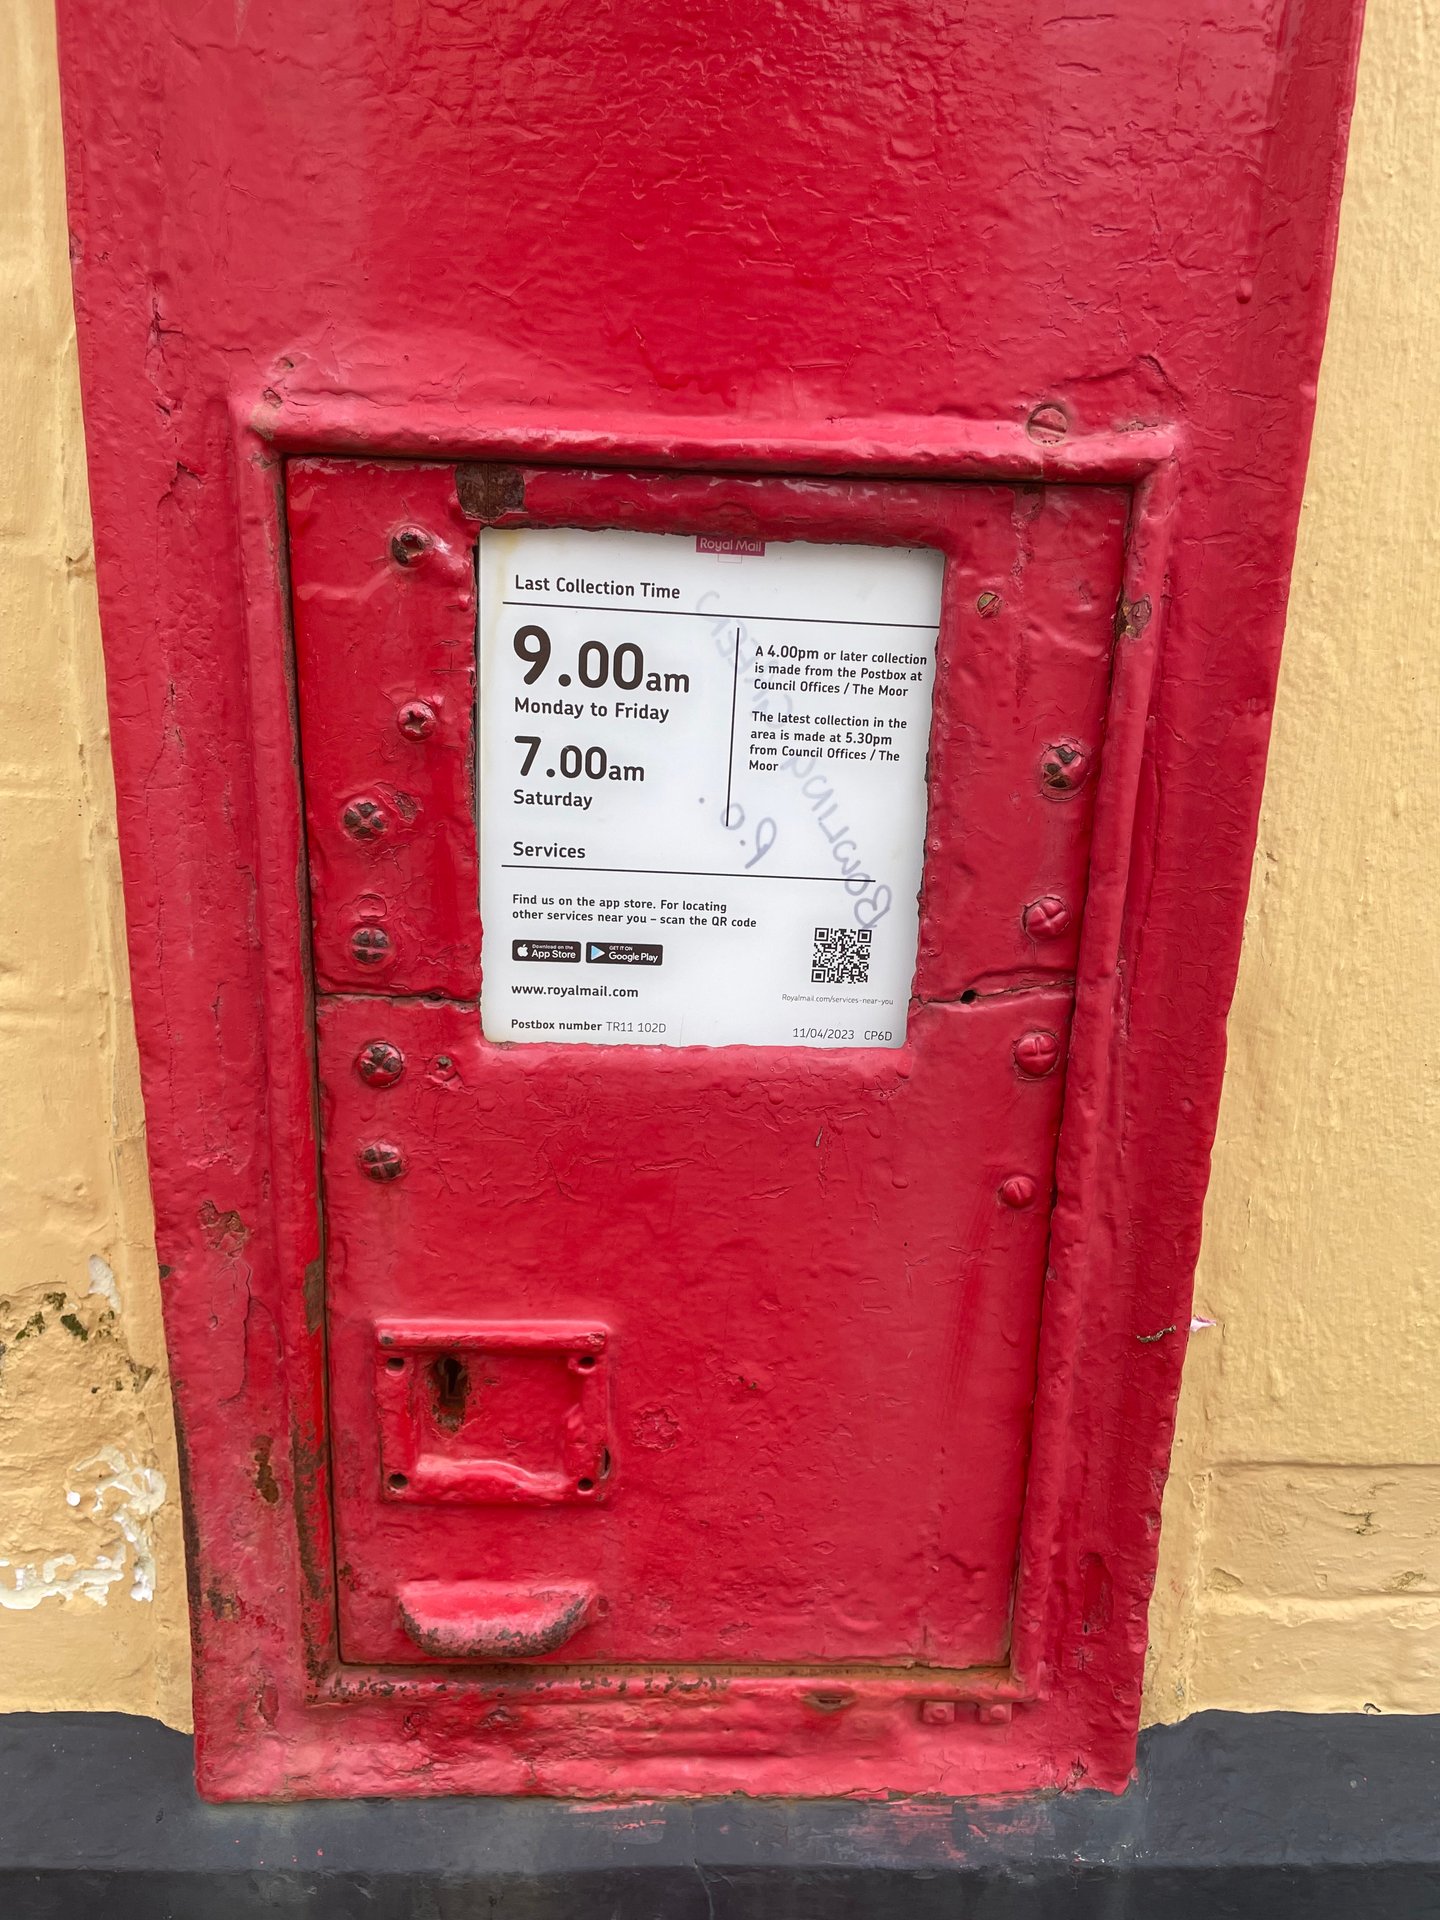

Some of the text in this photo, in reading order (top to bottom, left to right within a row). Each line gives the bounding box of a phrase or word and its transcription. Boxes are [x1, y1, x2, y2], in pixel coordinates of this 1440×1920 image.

[700, 537, 762, 553] Royal Mail
[515, 574, 681, 599] Last Collection Time
[513, 624, 690, 693] 9.00am
[755, 645, 928, 666] A 4.00pm or later collection
[755, 662, 923, 682] is made from the Postbox at
[754, 678, 796, 692] Council
[800, 680, 841, 695] Offices
[853, 683, 874, 695] The
[879, 685, 909, 697] Moor
[515, 697, 670, 724] Monday to Friday
[752, 711, 908, 729] The latest collection in the
[751, 729, 893, 747] area is made at 5.30pm
[514, 735, 645, 782] 7.00am
[750, 745, 777, 756] from
[782, 745, 824, 758] Council
[827, 748, 868, 761] Offices
[879, 750, 901, 762] The
[749, 760, 779, 771] Moor
[513, 789, 593, 810] Saturday
[513, 841, 586, 858] Services
[512, 894, 728, 914] Find us on the app store. For locating
[512, 909, 544, 920] other
[547, 910, 594, 922] services
[597, 913, 623, 923] near
[626, 914, 647, 925] you
[660, 915, 685, 926] scan
[689, 915, 707, 926] the
[711, 915, 727, 927] QR
[731, 917, 757, 928] code
[532, 950, 576, 959] App Store
[609, 951, 659, 963] Google Play
[511, 984, 639, 998] www.royalmail.com
[782, 994, 894, 1006] Royalmail.com/services-near-you
[511, 1019, 667, 1033] Postbox number TR11 102D
[792, 1028, 892, 1041] 11/04/2023 CP6D
